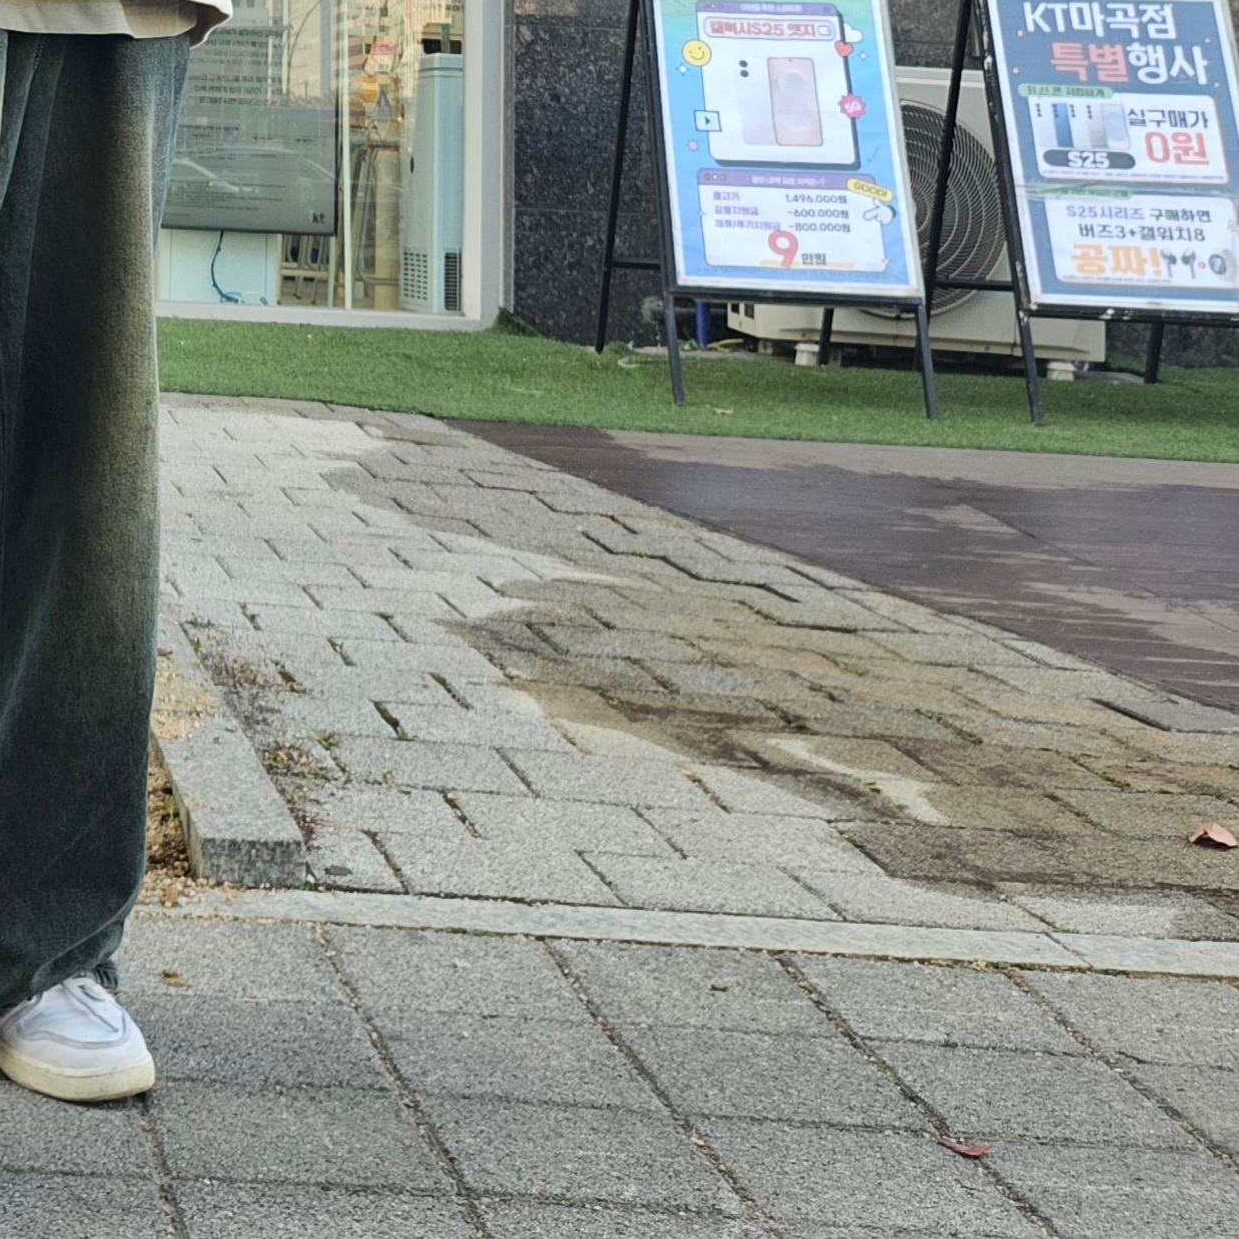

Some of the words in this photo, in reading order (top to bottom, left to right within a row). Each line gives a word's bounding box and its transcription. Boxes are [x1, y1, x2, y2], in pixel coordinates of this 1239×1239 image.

[1022, 1, 1177, 40] KT마곡점
[1049, 41, 1209, 85] 특별행사
[1127, 107, 1209, 129] 실구매가
[1067, 150, 1110, 169] S25
[1144, 131, 1210, 166] 0원
[312, 211, 326, 225] kt
[1066, 205, 1146, 221] S25시리즈
[1149, 208, 1212, 224] 구매하면
[1071, 243, 1162, 277] 공짜!
